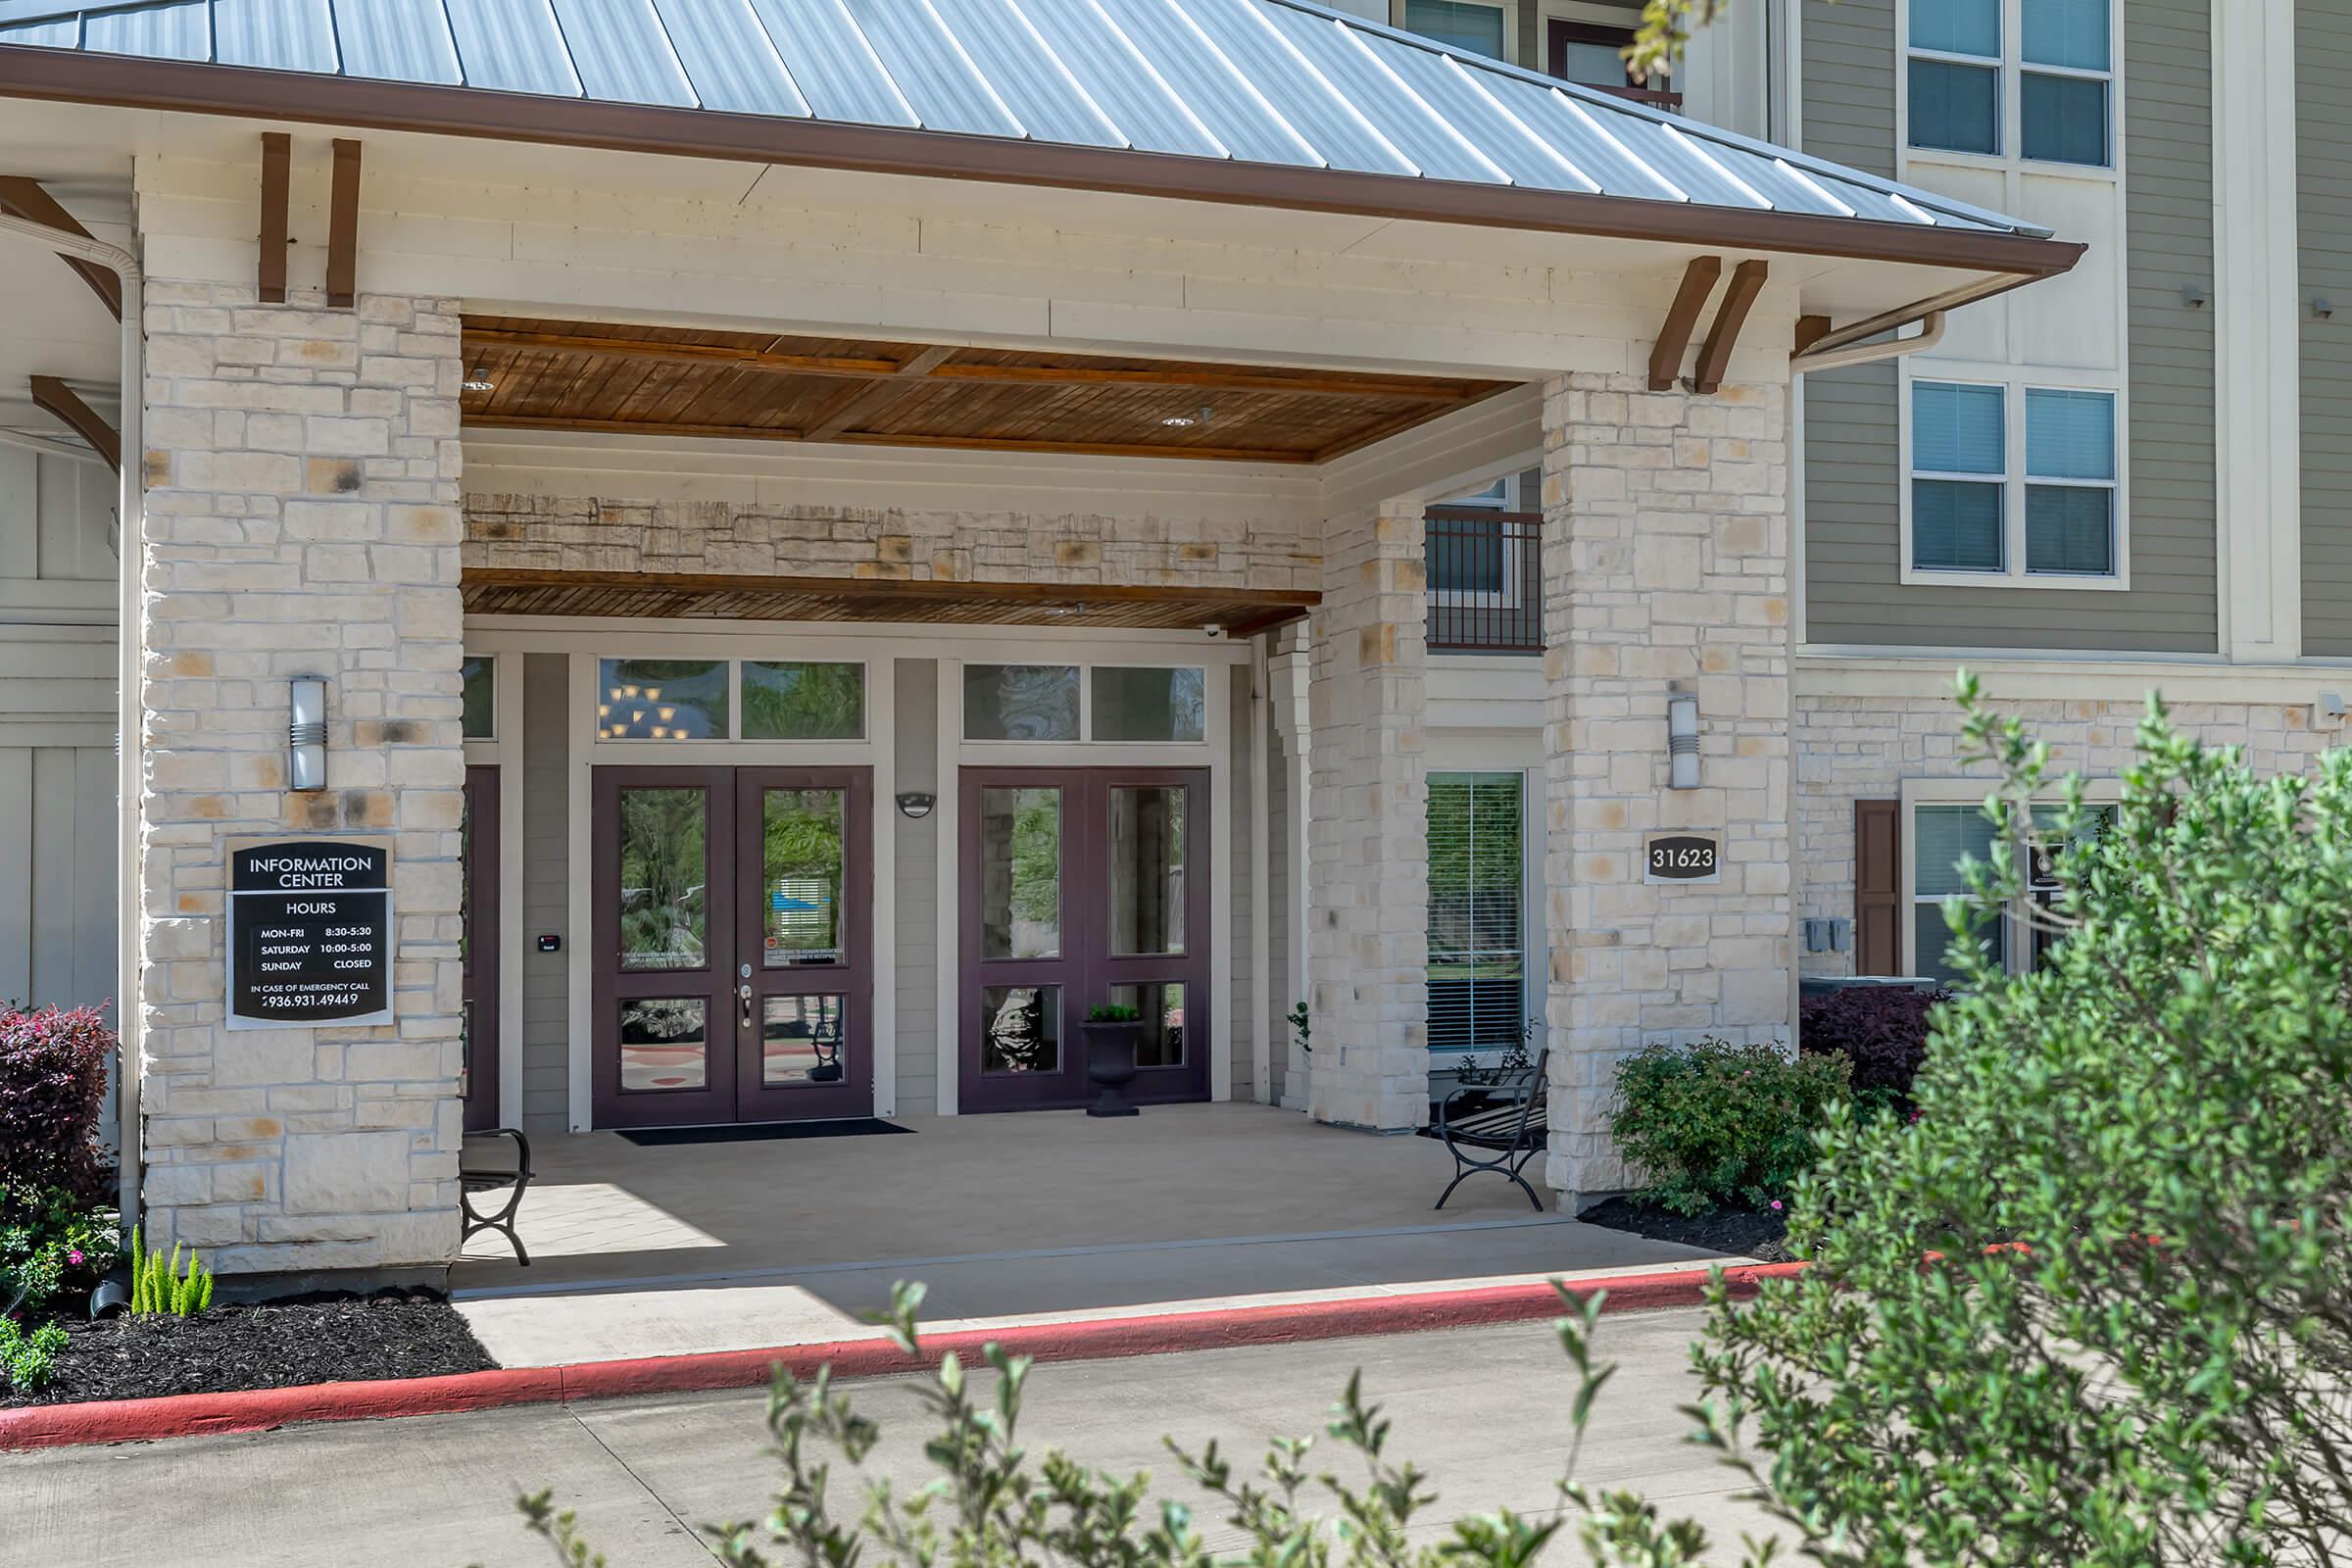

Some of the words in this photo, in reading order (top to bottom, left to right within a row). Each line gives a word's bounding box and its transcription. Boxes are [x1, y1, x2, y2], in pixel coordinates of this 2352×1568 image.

[1652, 848, 1714, 867] 31623
[250, 857, 371, 872] INFORMATION
[279, 873, 344, 888] CENTER
[286, 903, 336, 914] HOURS
[261, 928, 305, 939] MON-FRI
[325, 927, 371, 937] 8:30-5:30
[261, 945, 311, 956] SATURDAY
[320, 943, 371, 953] 10:00-5:00
[261, 961, 302, 971] SUNDAY
[333, 959, 371, 969] CLOSED
[299, 983, 349, 992] EMERGENCY
